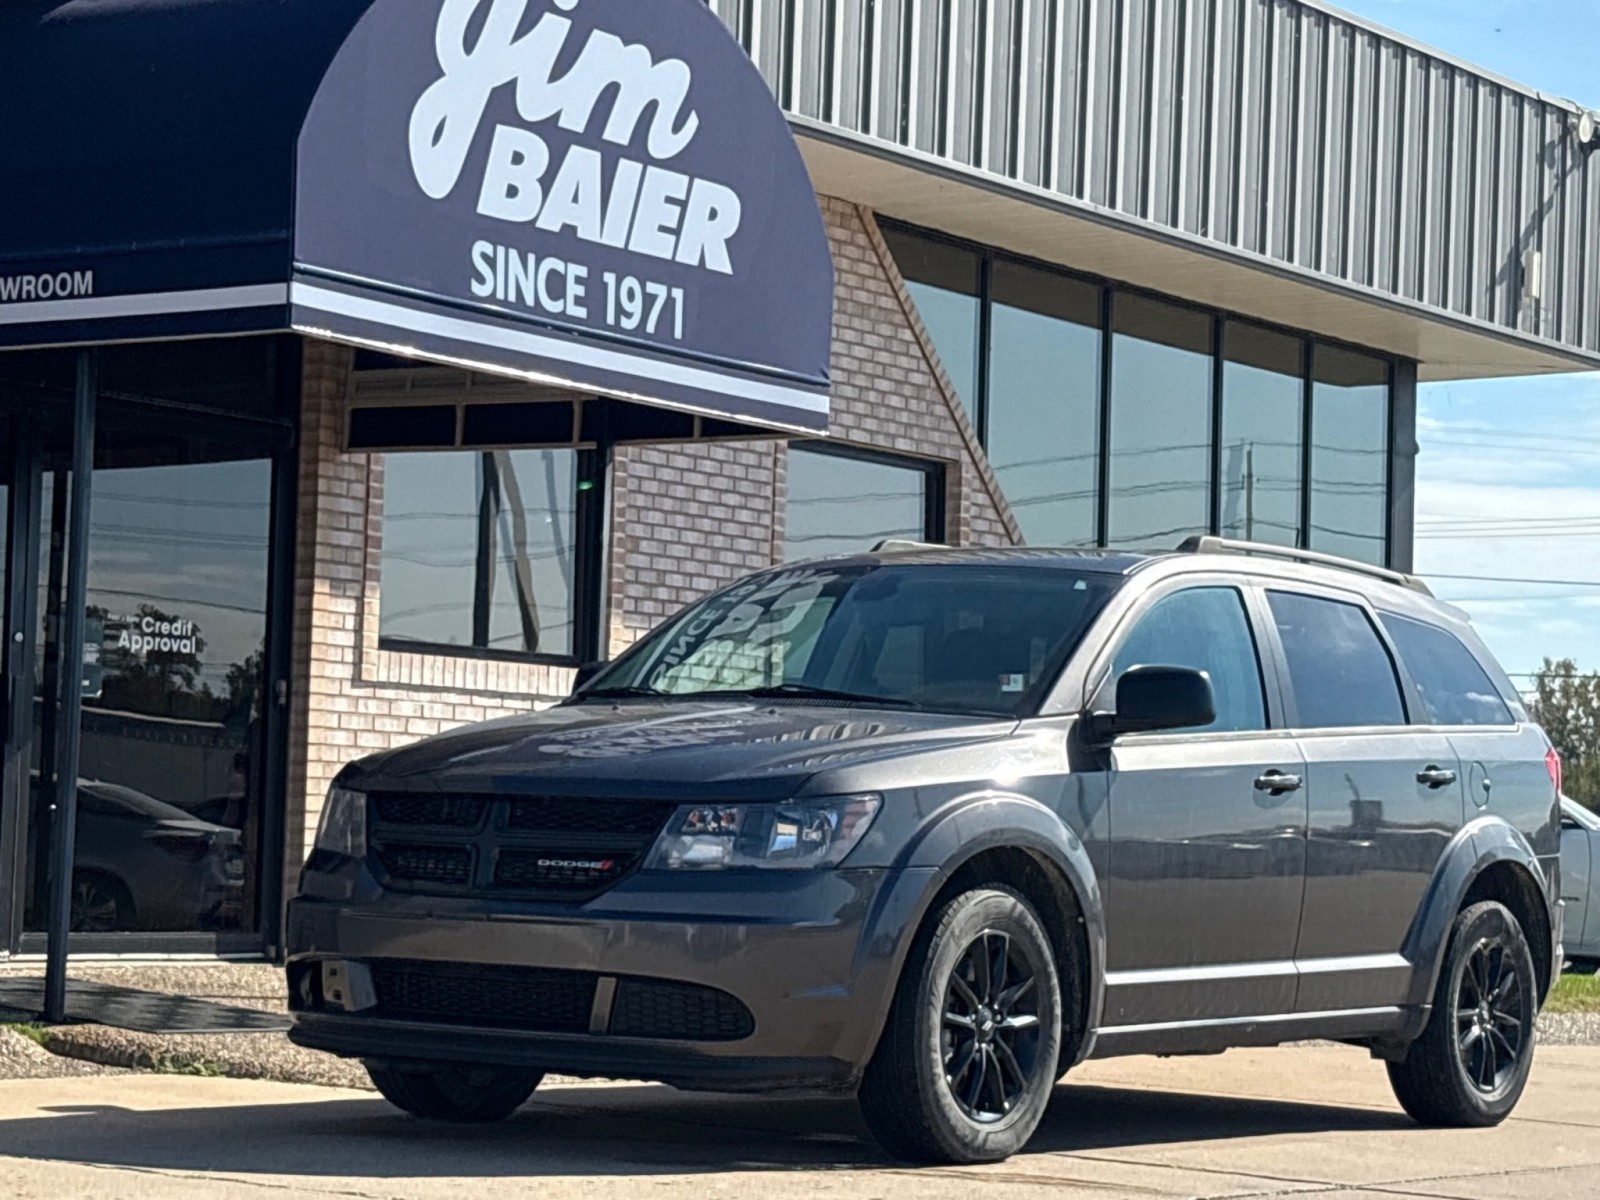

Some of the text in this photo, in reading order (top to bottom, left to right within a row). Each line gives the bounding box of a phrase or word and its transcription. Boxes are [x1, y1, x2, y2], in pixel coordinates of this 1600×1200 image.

[408, 0, 699, 199] Jim
[477, 124, 740, 275] BAIER
[0, 271, 93, 301] WROOM
[470, 239, 684, 340] SINCE 1971
[141, 616, 193, 637] Credit
[118, 630, 196, 655] Approval
[537, 859, 602, 869] DODGE
